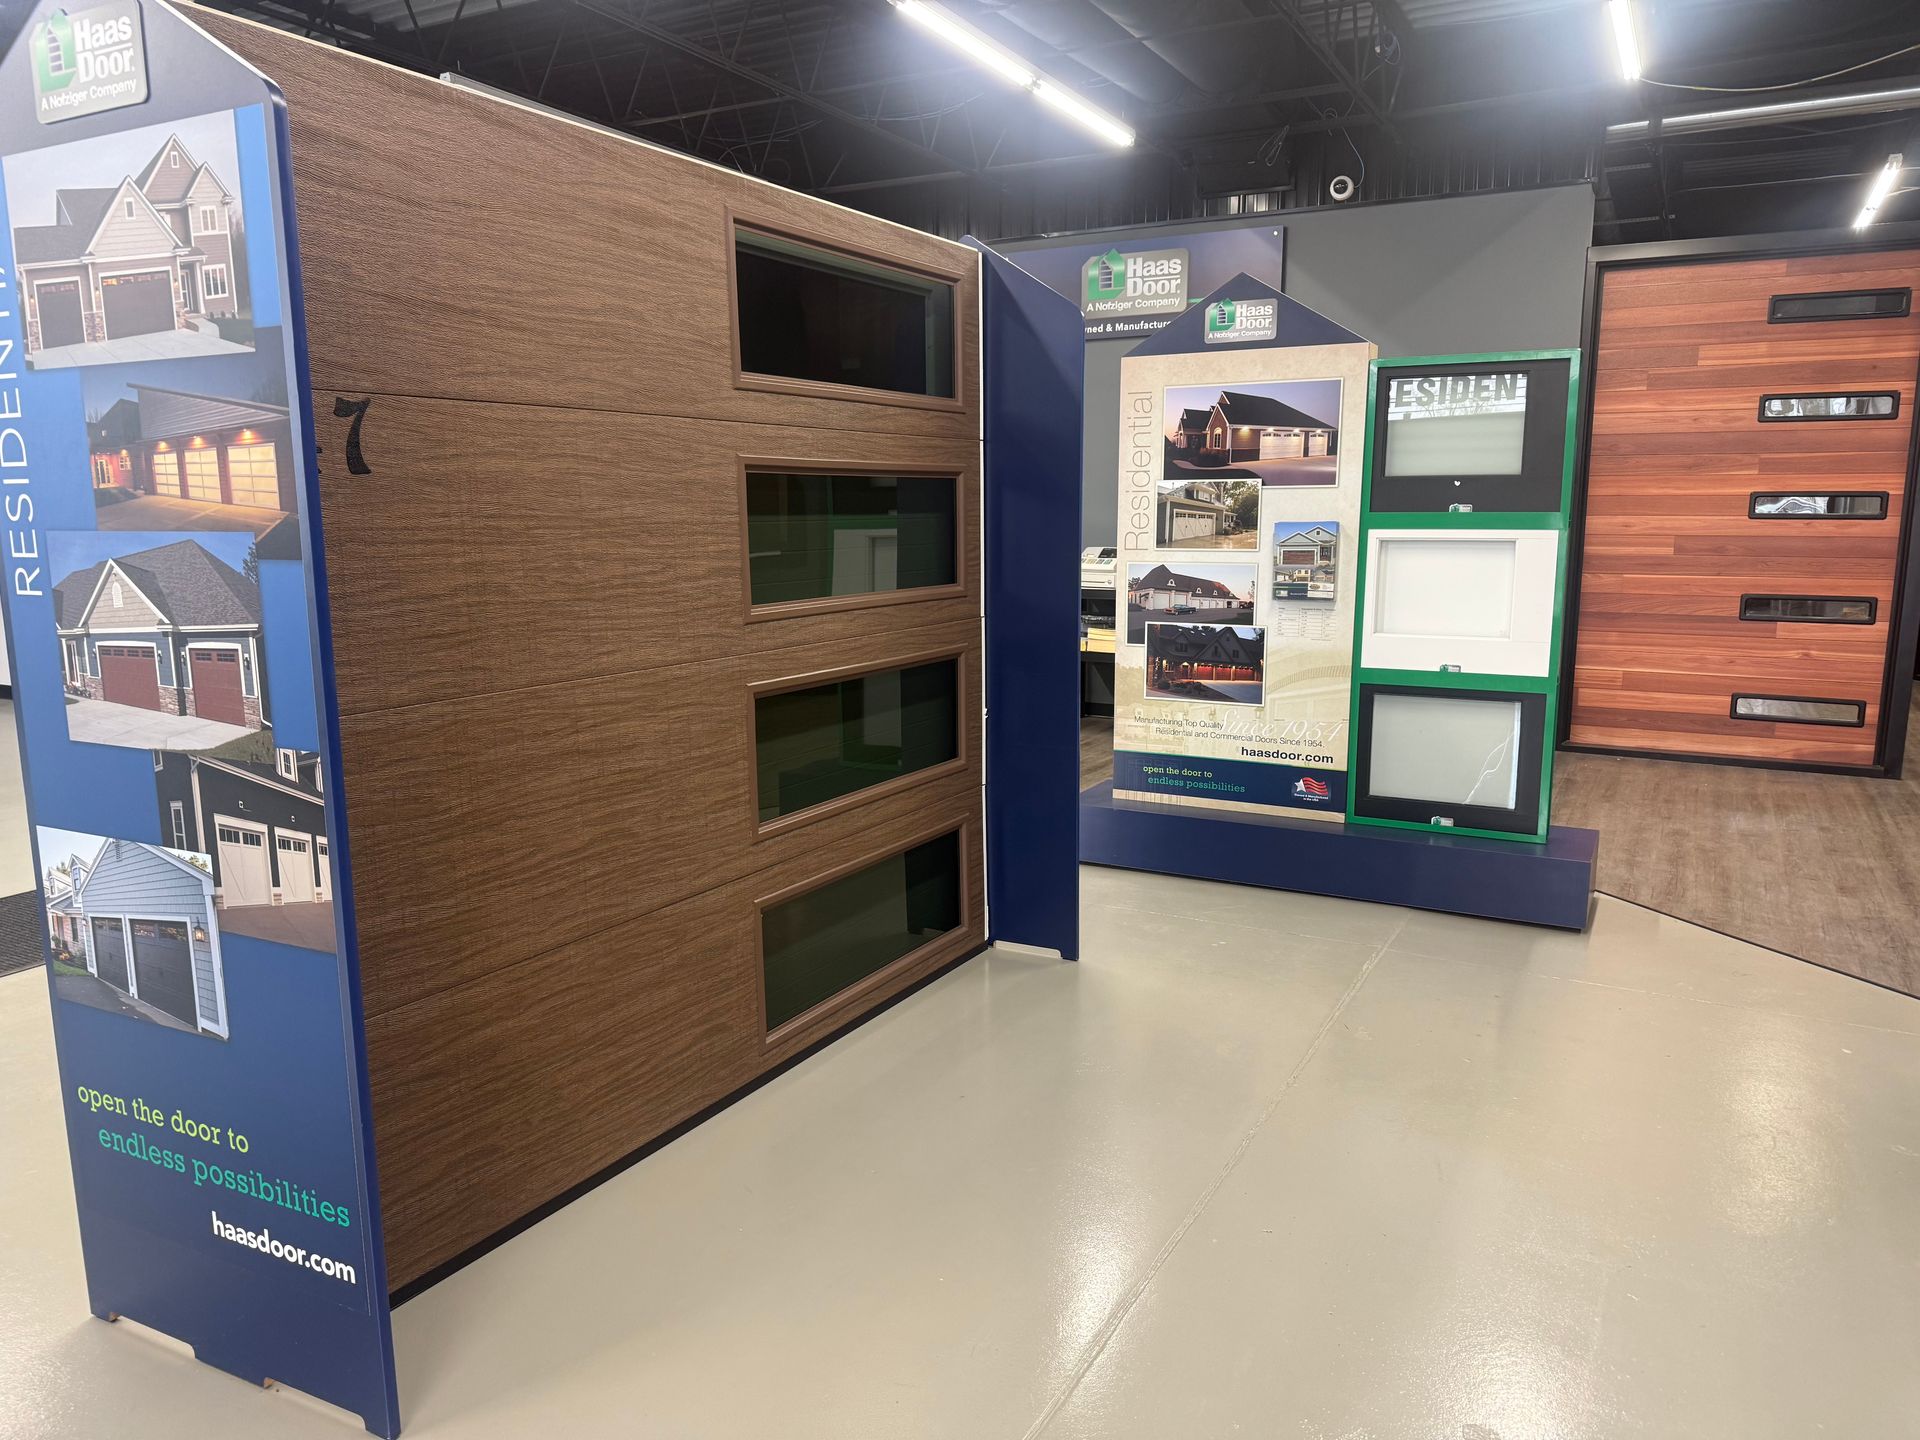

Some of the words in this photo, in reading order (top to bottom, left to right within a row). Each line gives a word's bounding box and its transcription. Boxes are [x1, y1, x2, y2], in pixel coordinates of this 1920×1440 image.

[73, 16, 132, 52] Haas
[41, 97, 49, 111] A
[90, 79, 137, 99] Company
[1127, 257, 1182, 277] Haas
[1086, 303, 1094, 312] A
[1135, 297, 1180, 309] Company
[1236, 304, 1273, 317] Haas
[1105, 323, 1113, 332] &
[1124, 390, 1153, 550] Residential
[1134, 716, 1182, 727] Manufacturing
[1184, 719, 1197, 728] Top
[1199, 720, 1223, 730] Quality
[1219, 708, 1273, 736] Since
[1281, 720, 1343, 742] 1954
[1155, 728, 1193, 737] Residential
[1210, 732, 1253, 742] Commercial
[1255, 735, 1277, 744] Doors
[1279, 737, 1300, 746] Since
[1241, 746, 1334, 764] haasdoor.com
[1143, 766, 1164, 774] open
[1166, 767, 1179, 775] the
[1181, 768, 1202, 777] door
[1147, 776, 1184, 787] endless
[1186, 780, 1246, 793] possibilities
[77, 1085, 127, 1116] open
[132, 1098, 164, 1127] the
[170, 1110, 220, 1145] door
[227, 1128, 249, 1153] to
[98, 1127, 186, 1173] endless
[191, 1158, 350, 1228] possibilities
[211, 1210, 356, 1284] haasdoor.com
